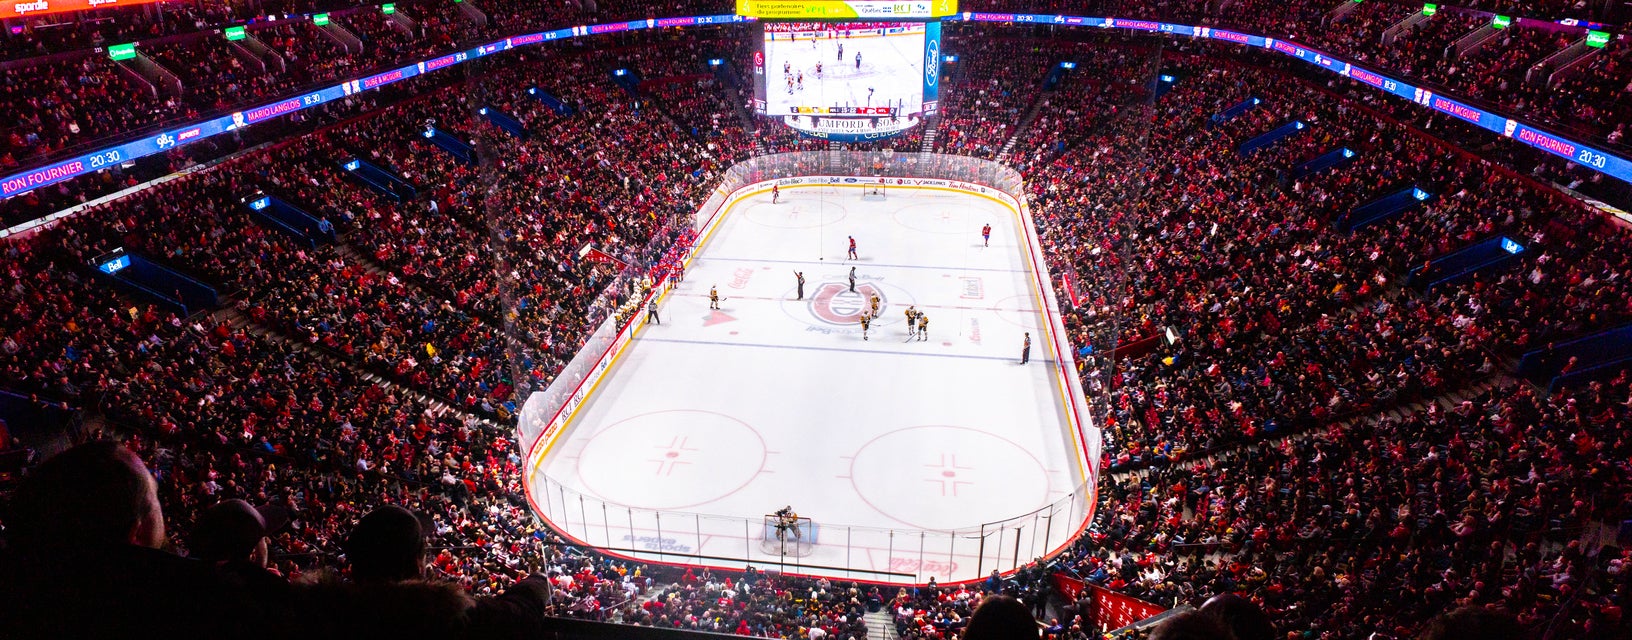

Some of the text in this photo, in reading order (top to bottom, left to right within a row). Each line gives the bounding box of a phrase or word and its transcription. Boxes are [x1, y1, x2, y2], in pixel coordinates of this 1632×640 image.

[15, 1, 48, 14] spordle
[756, 66, 762, 74] LG
[928, 48, 936, 77] Ford
[1351, 68, 1363, 80] MARIO
[1362, 72, 1382, 86] LANGLOIS
[248, 94, 320, 121] MARIO LANGLOIS 18:30
[1435, 98, 1449, 110] DUBÉ
[1454, 105, 1480, 122] MCGUIRE
[815, 120, 864, 128] UMFORD
[1520, 128, 1606, 168] RON FOURNIER 20:30
[2, 150, 120, 194] RON FOURNIER 20:30
[108, 259, 122, 272] Bell
[645, 543, 691, 552] sports
